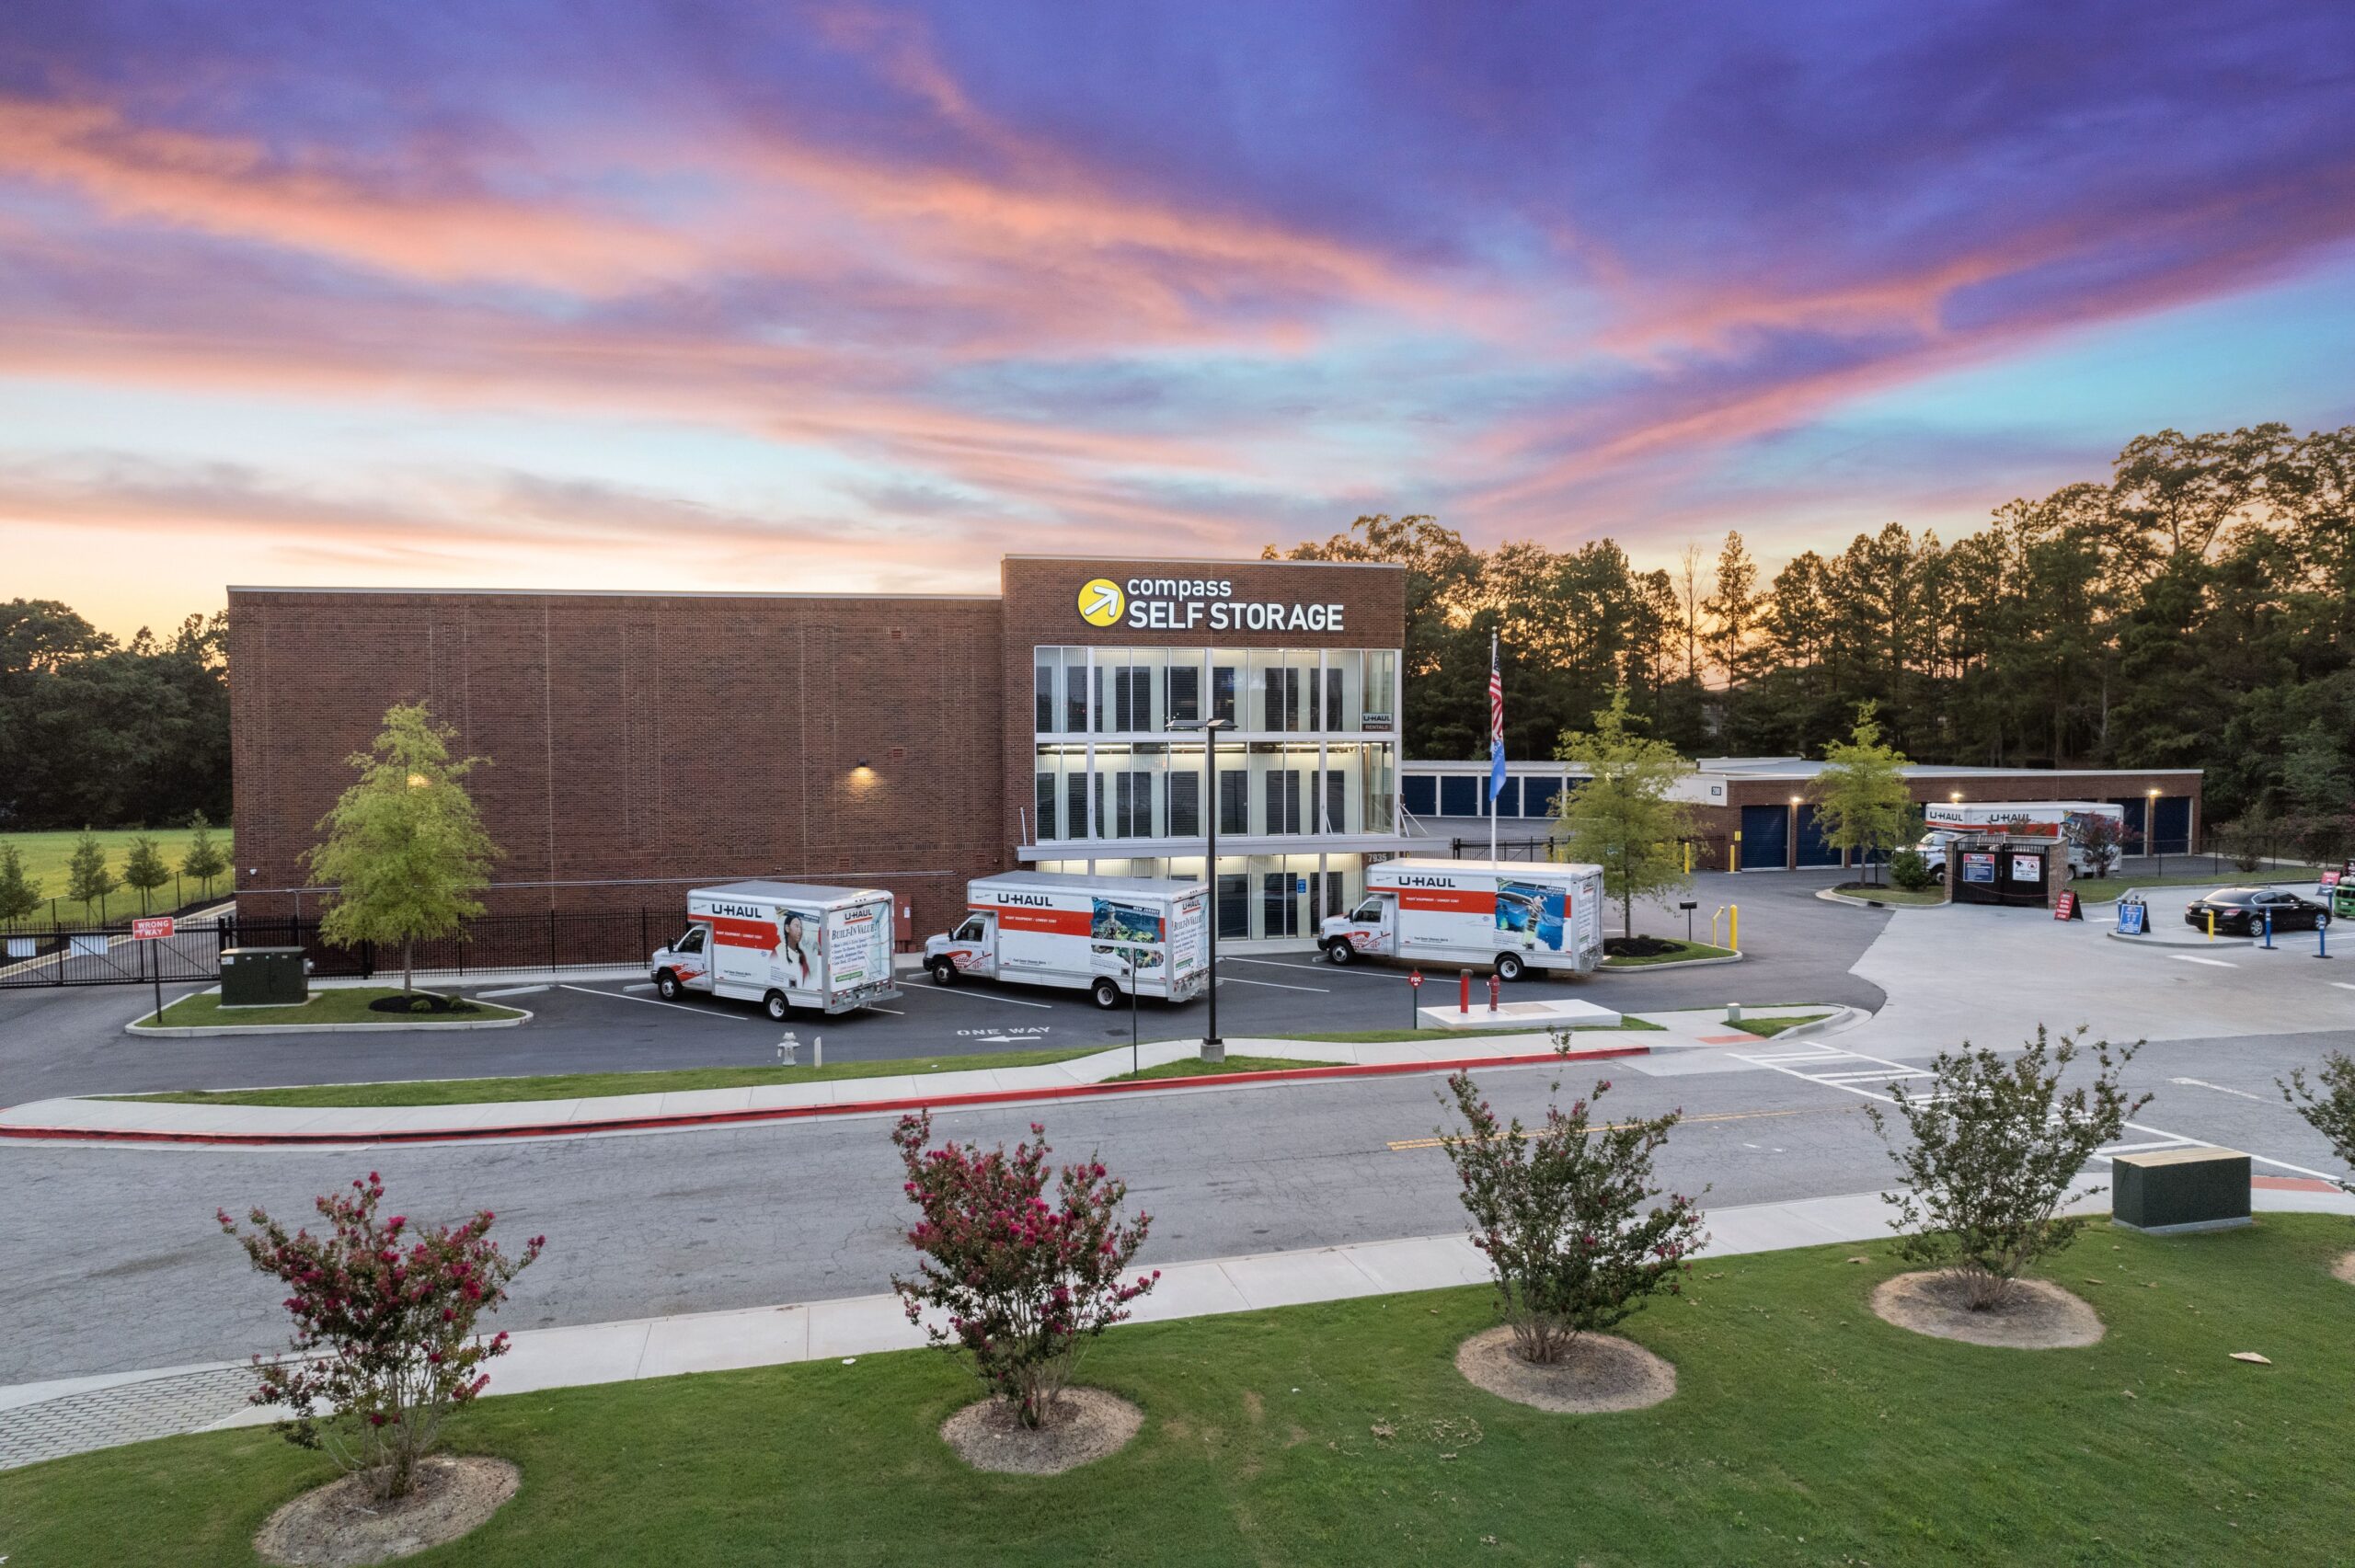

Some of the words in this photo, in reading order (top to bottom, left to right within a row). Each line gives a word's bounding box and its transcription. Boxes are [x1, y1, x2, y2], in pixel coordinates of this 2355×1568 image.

[1127, 578, 1232, 601] compass
[1128, 601, 1204, 629] SELF
[1209, 602, 1344, 631] STORAGE
[1929, 811, 1963, 821] U-HAUL
[1990, 813, 2032, 822] U-HAUL
[1368, 853, 1387, 863] 7935
[1398, 876, 1456, 888] U-HAUL
[997, 893, 1053, 907] U-HAUL
[711, 903, 763, 919] U-HAUL
[844, 908, 873, 921] U-HAUL
[138, 920, 169, 929] WRONG
